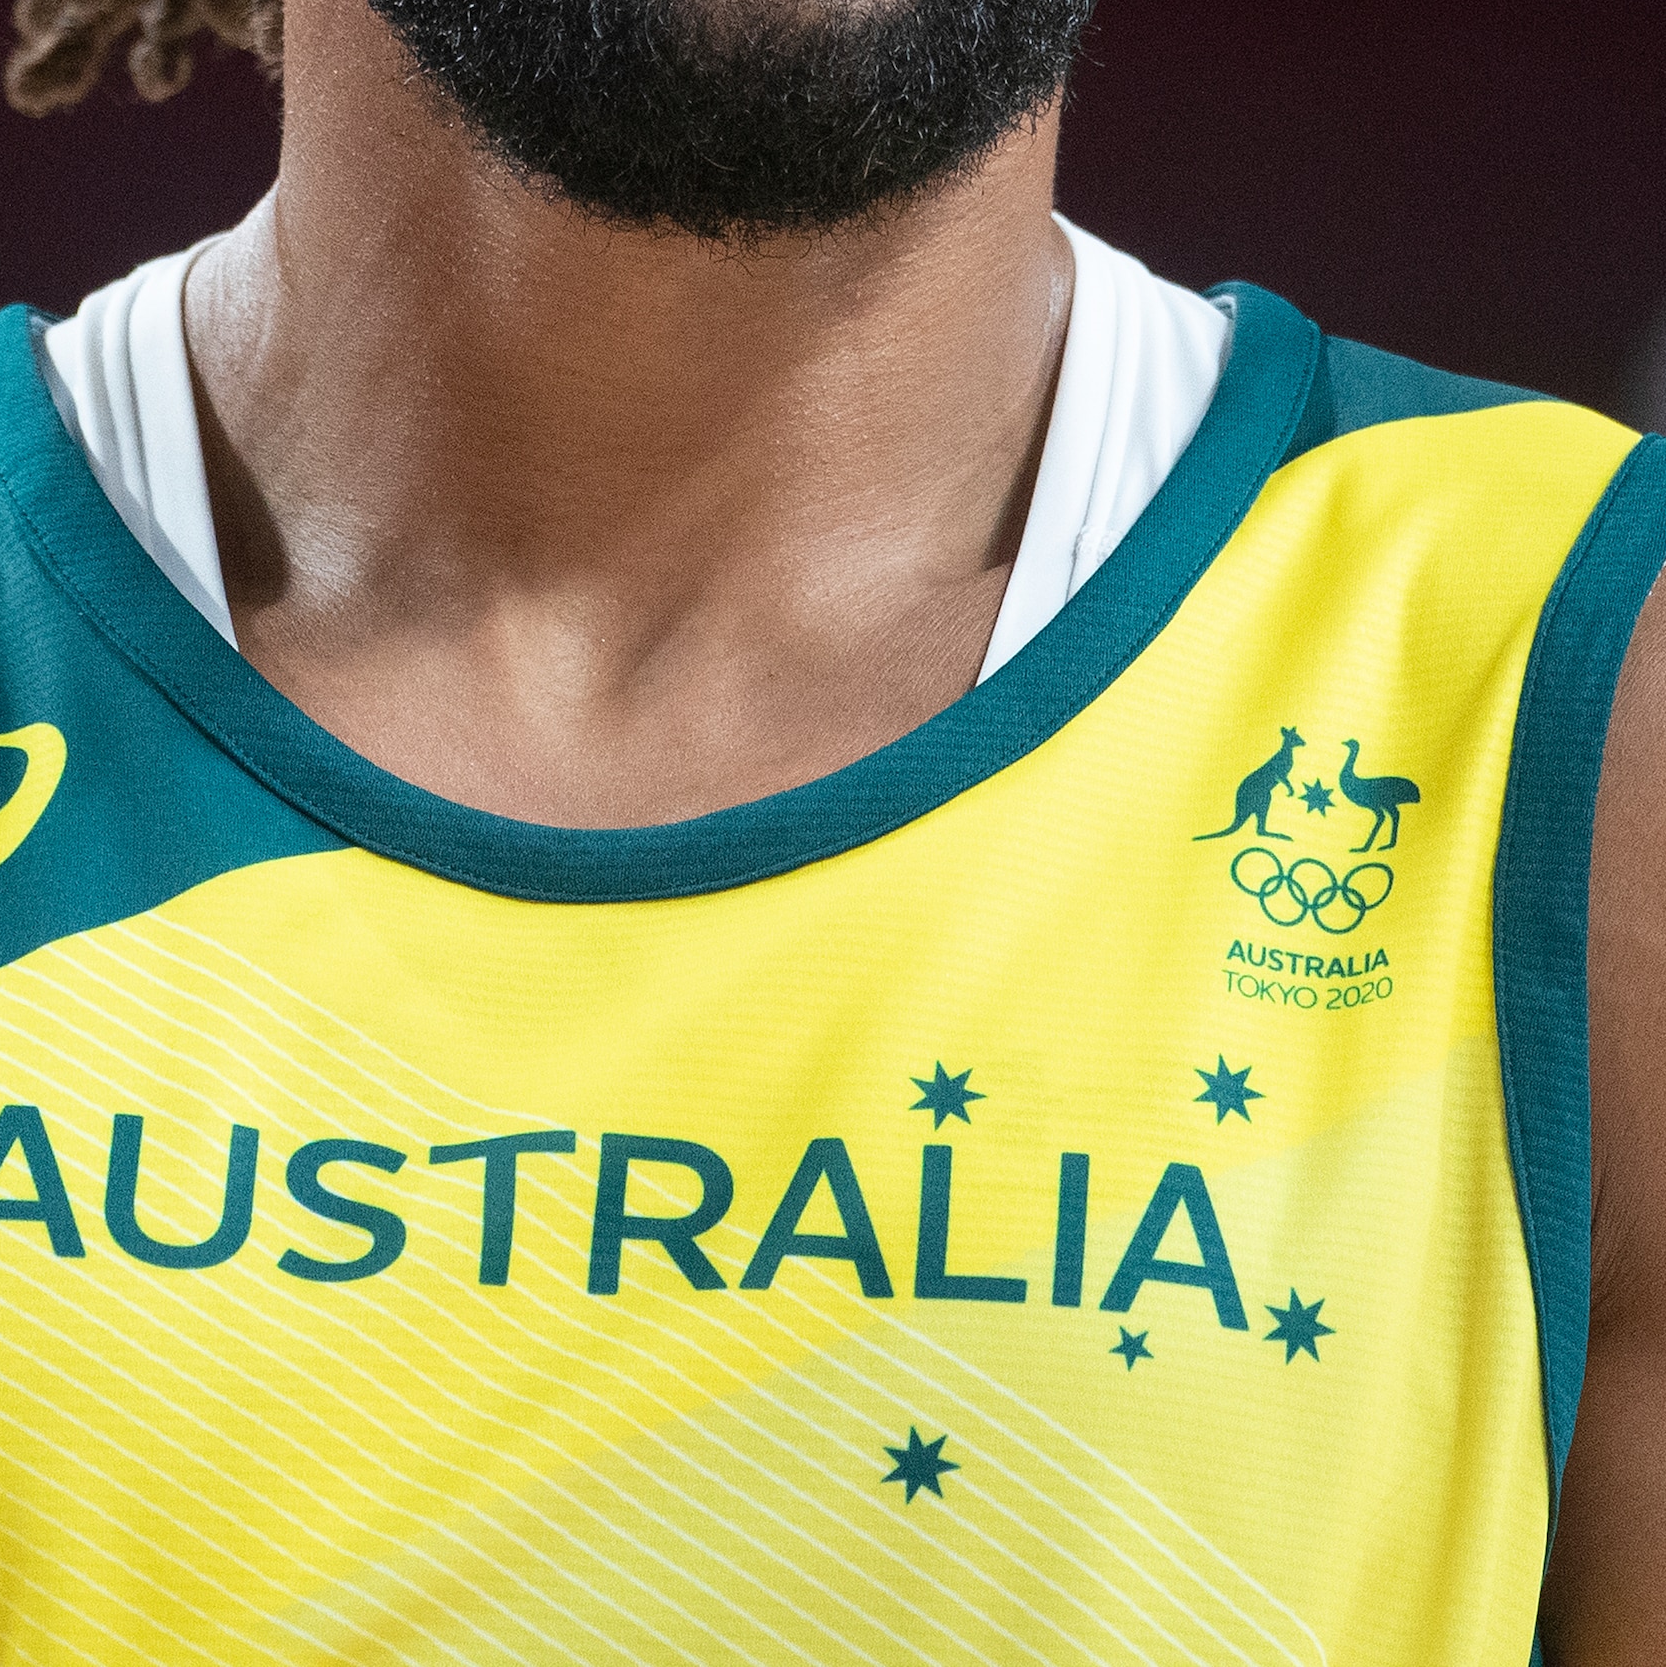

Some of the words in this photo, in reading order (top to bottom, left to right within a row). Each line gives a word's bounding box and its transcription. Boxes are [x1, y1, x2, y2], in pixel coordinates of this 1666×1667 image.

[1227, 940, 1389, 978] AUSTRALIA
[1223, 970, 1318, 1009] TOKYO
[1326, 977, 1393, 1010] 2020
